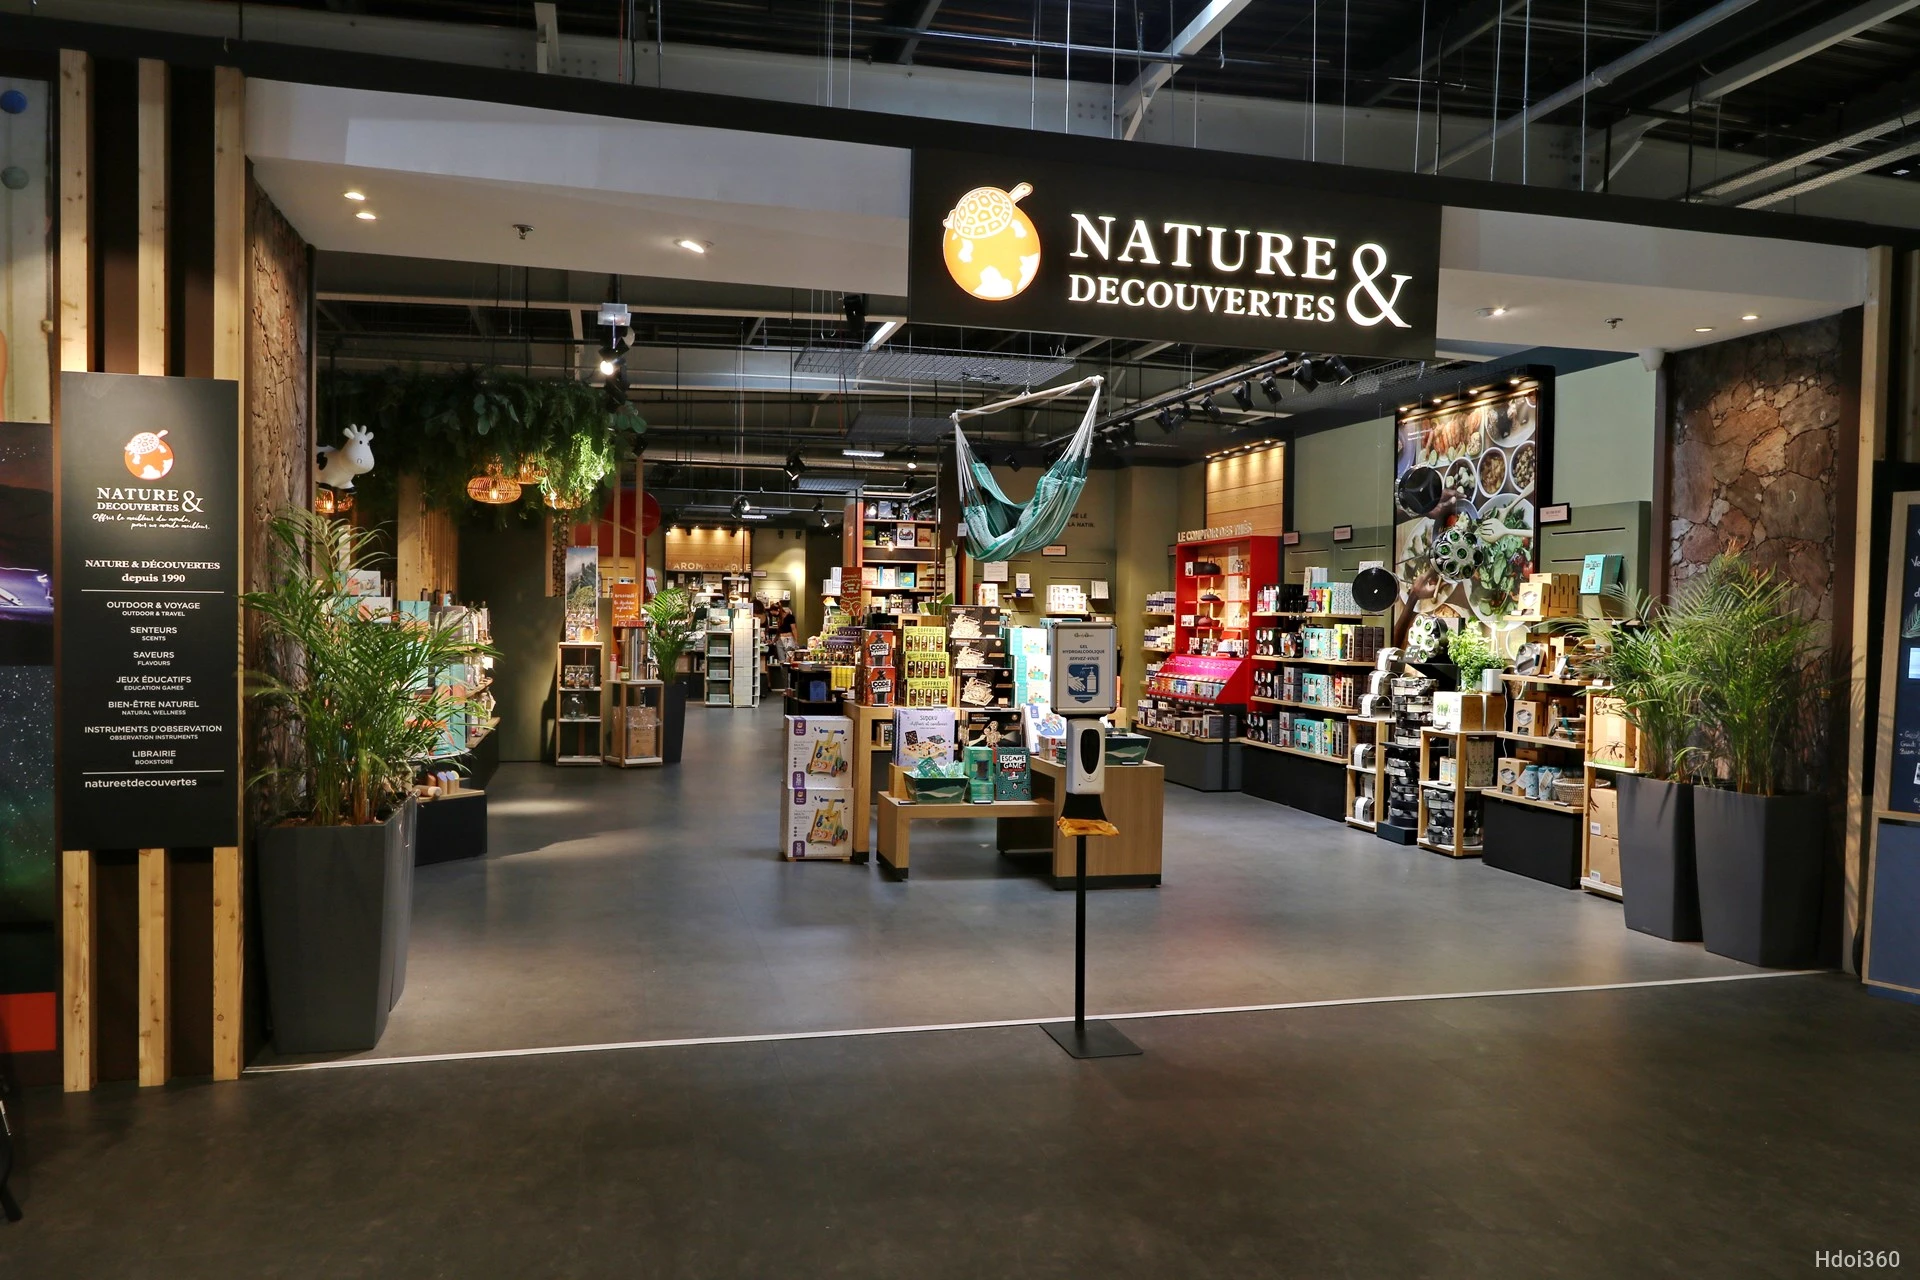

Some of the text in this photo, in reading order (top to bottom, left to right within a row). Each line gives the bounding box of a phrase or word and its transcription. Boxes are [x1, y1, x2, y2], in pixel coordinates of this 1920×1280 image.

[1069, 212, 1413, 329] NATURE &
[1068, 273, 1336, 323] DECOUVERTES
[96, 487, 204, 513] NATURE &
[97, 502, 179, 512] DECOUVERTES
[1178, 531, 1186, 542] LE
[1186, 527, 1218, 541] COMPTOIR
[1220, 526, 1233, 536] DES
[85, 560, 129, 568] NATURE
[141, 559, 221, 570] DÉCOUVERTES
[122, 573, 185, 584] depuis 1990
[106, 601, 154, 609] OUTDOOR
[130, 626, 178, 634] SENTEURS
[133, 651, 175, 659] SAVEURS
[141, 675, 191, 683] ÉDUCATIFS
[108, 700, 156, 708] BIEN-ÊTRE
[132, 750, 176, 758] LIBRAIRIE
[85, 778, 197, 788] natureetdecouvertes
